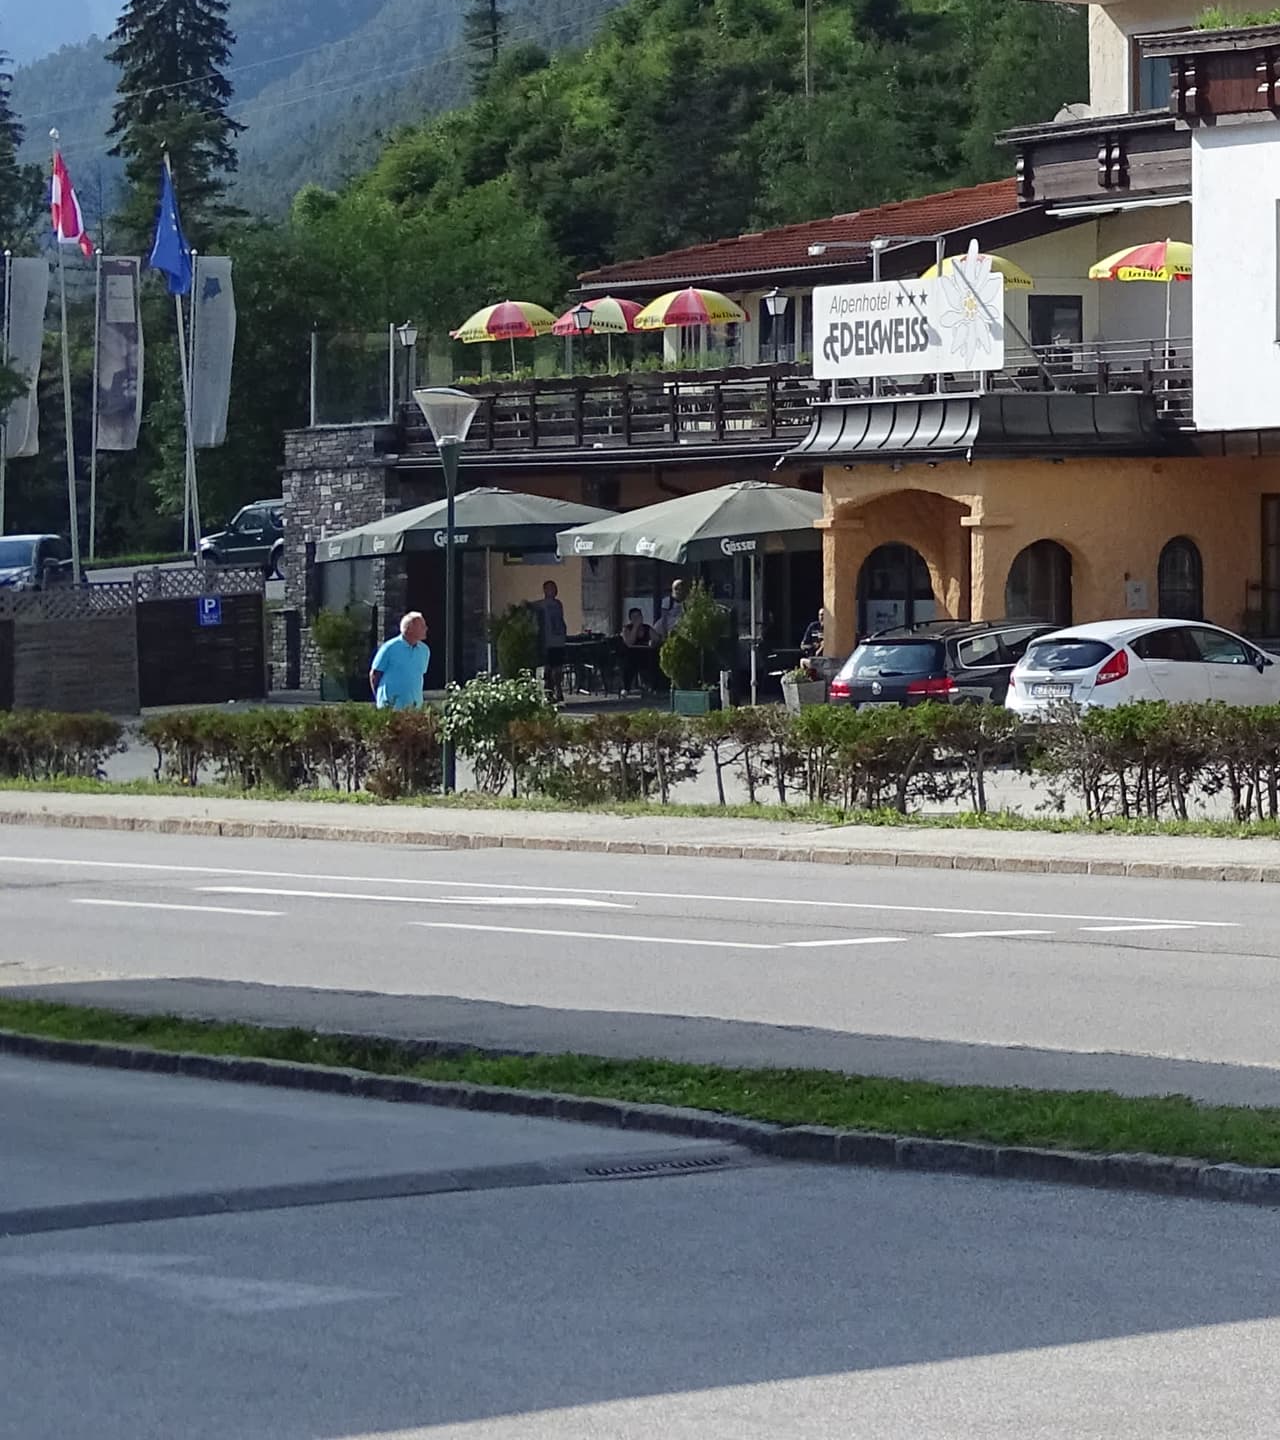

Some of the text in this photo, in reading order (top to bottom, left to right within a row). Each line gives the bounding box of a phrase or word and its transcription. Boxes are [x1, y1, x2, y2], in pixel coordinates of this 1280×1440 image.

[829, 291, 891, 316] Alpenhotel
[592, 320, 624, 330] ulius
[823, 316, 929, 364] EDELWEISS
[720, 537, 756, 556] Gösser
[204, 599, 216, 613] P
